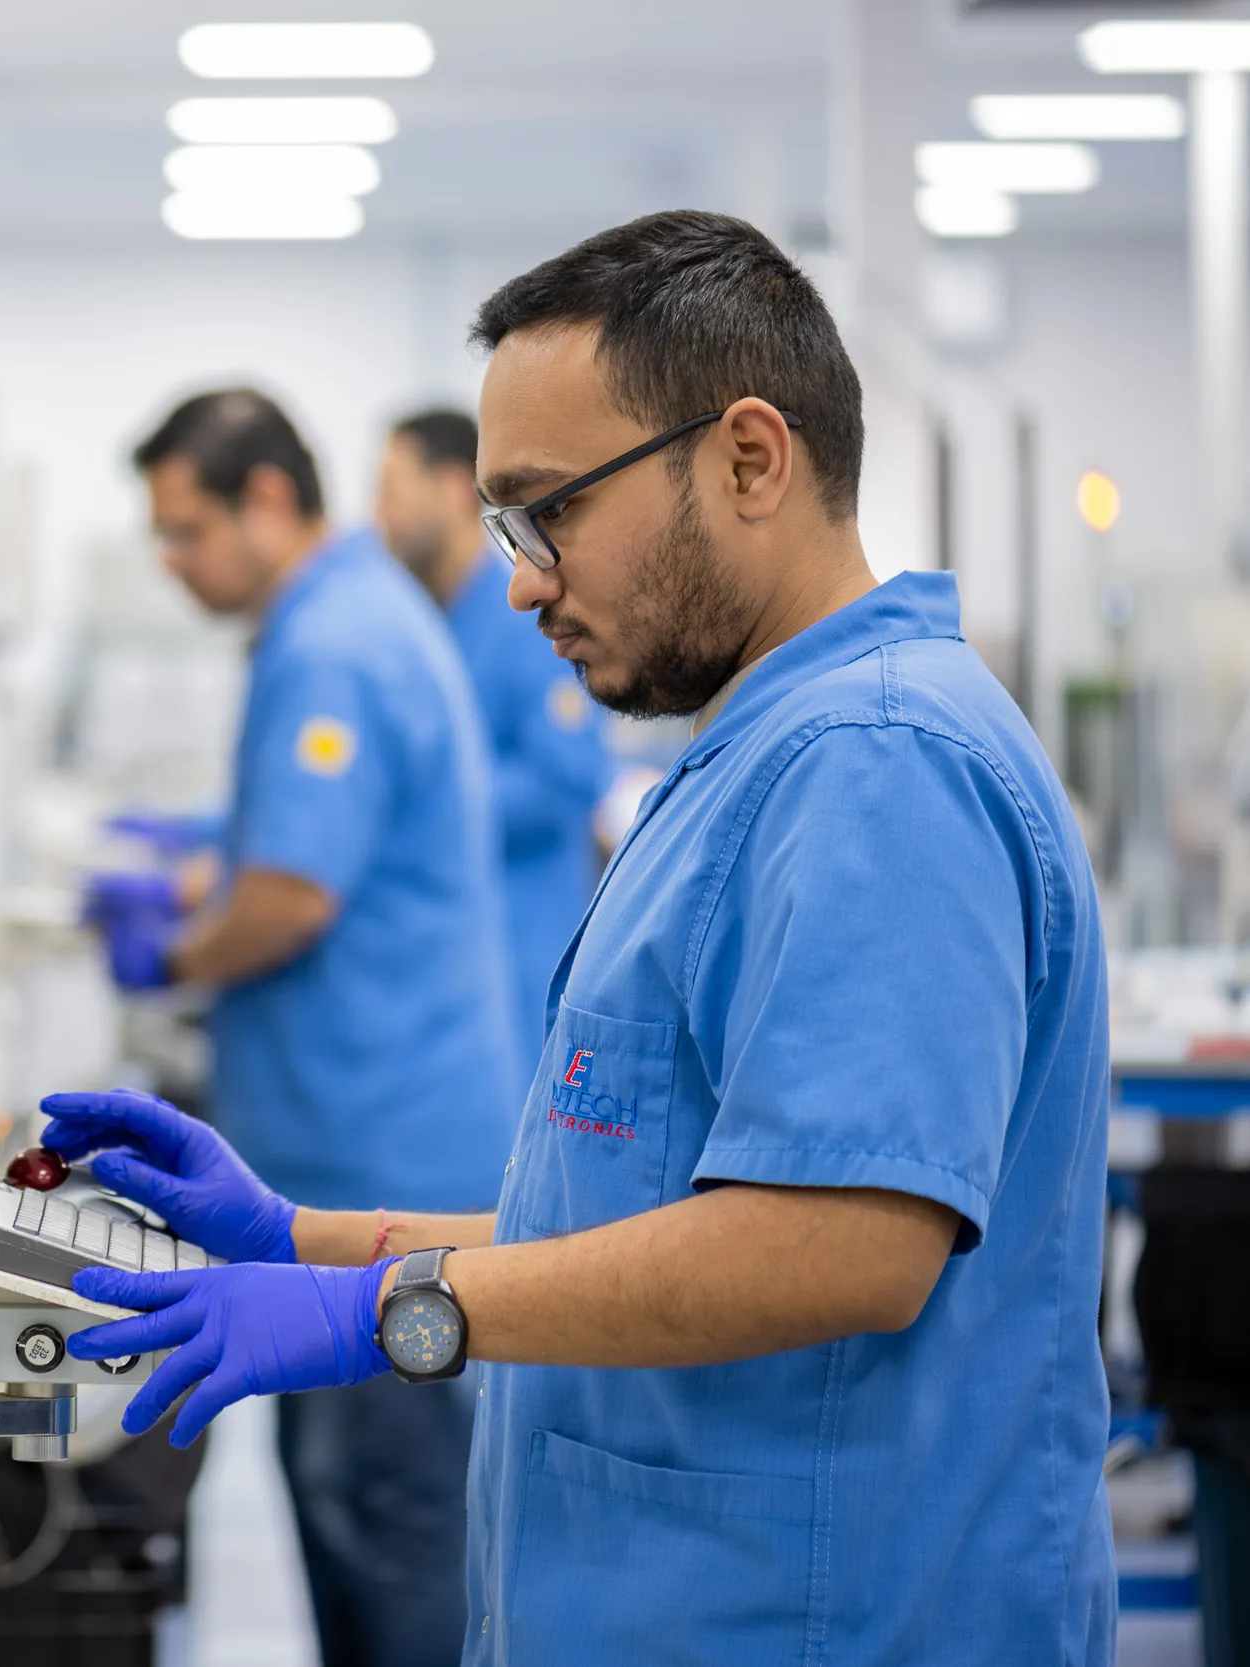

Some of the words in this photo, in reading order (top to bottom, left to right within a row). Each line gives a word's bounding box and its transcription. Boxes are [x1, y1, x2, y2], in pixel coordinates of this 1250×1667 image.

[564, 1050, 593, 1087] E
[29, 1339, 45, 1359] LED2
[39, 1347, 50, 1360] 2D
